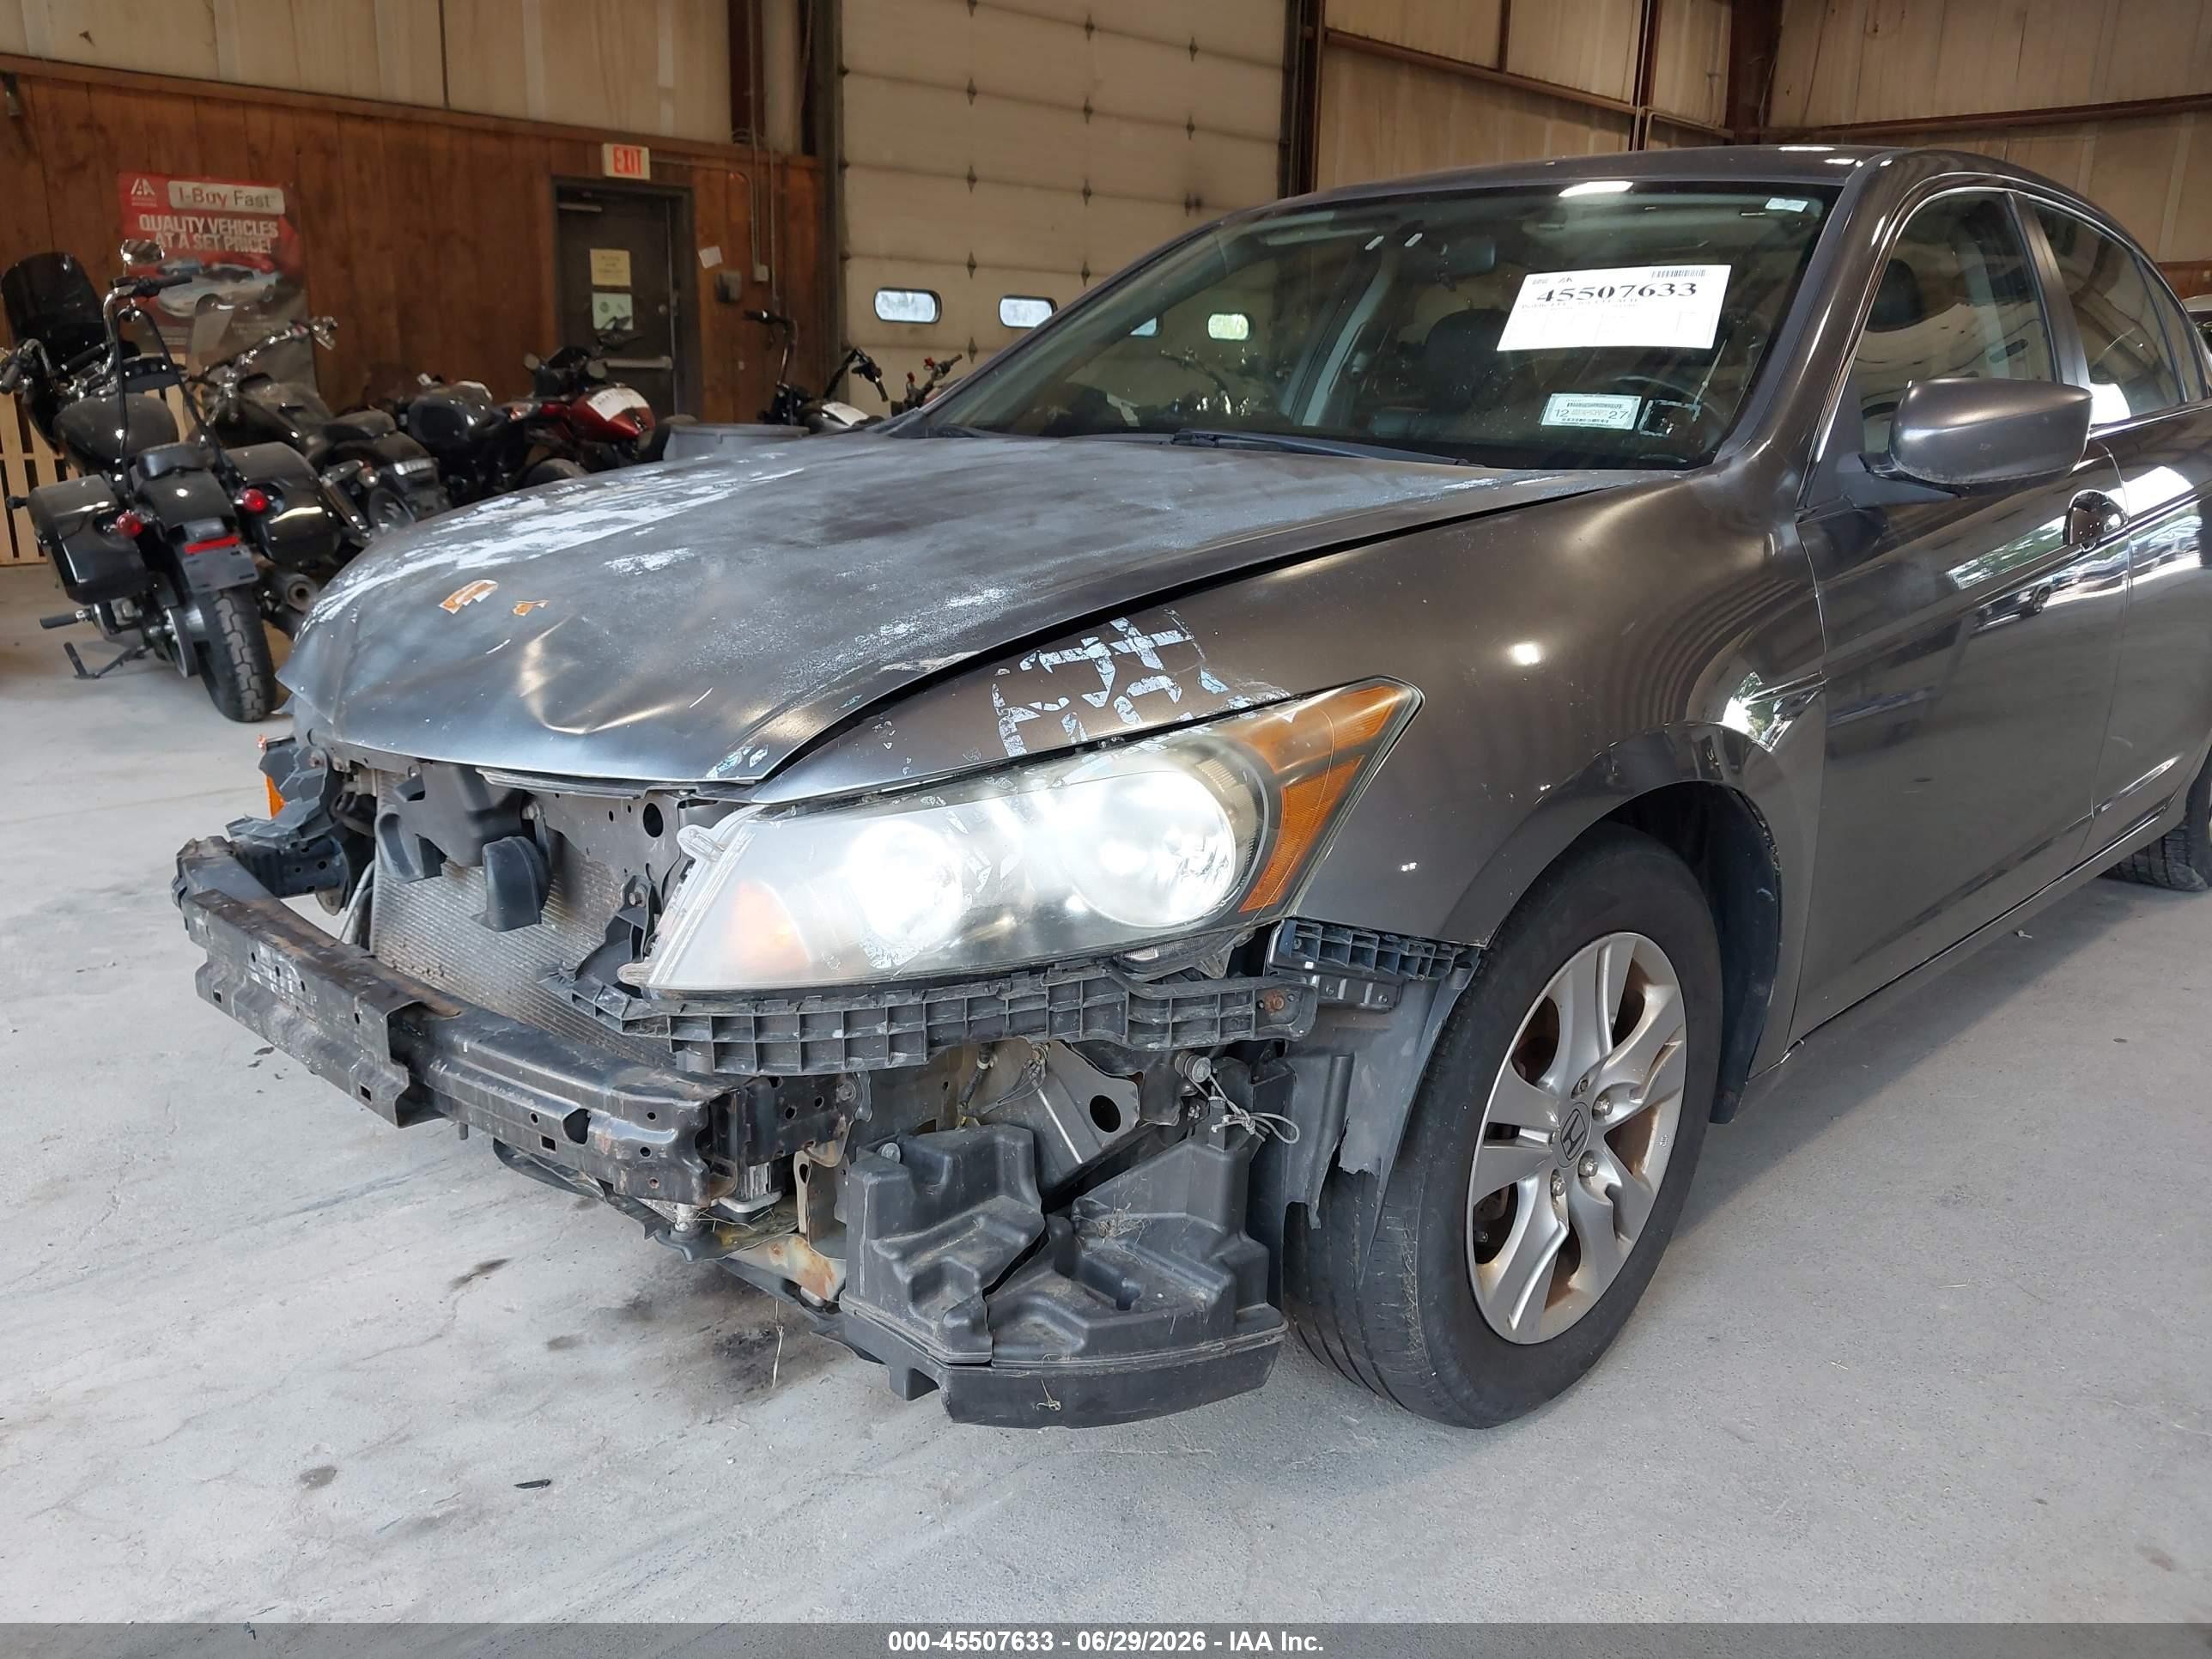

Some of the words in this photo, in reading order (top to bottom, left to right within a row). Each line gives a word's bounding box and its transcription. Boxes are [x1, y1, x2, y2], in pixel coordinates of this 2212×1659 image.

[612, 145, 642, 178] EXIT
[178, 186, 228, 208] I-Buy
[234, 190, 270, 208] Fast
[139, 215, 205, 234] QUALITY
[205, 217, 279, 239] VEHICLES
[155, 233, 175, 249] AT
[178, 234, 191, 250] A
[193, 234, 221, 252] SET
[1536, 282, 1698, 302] 45507633
[1608, 410, 1629, 421] 27
